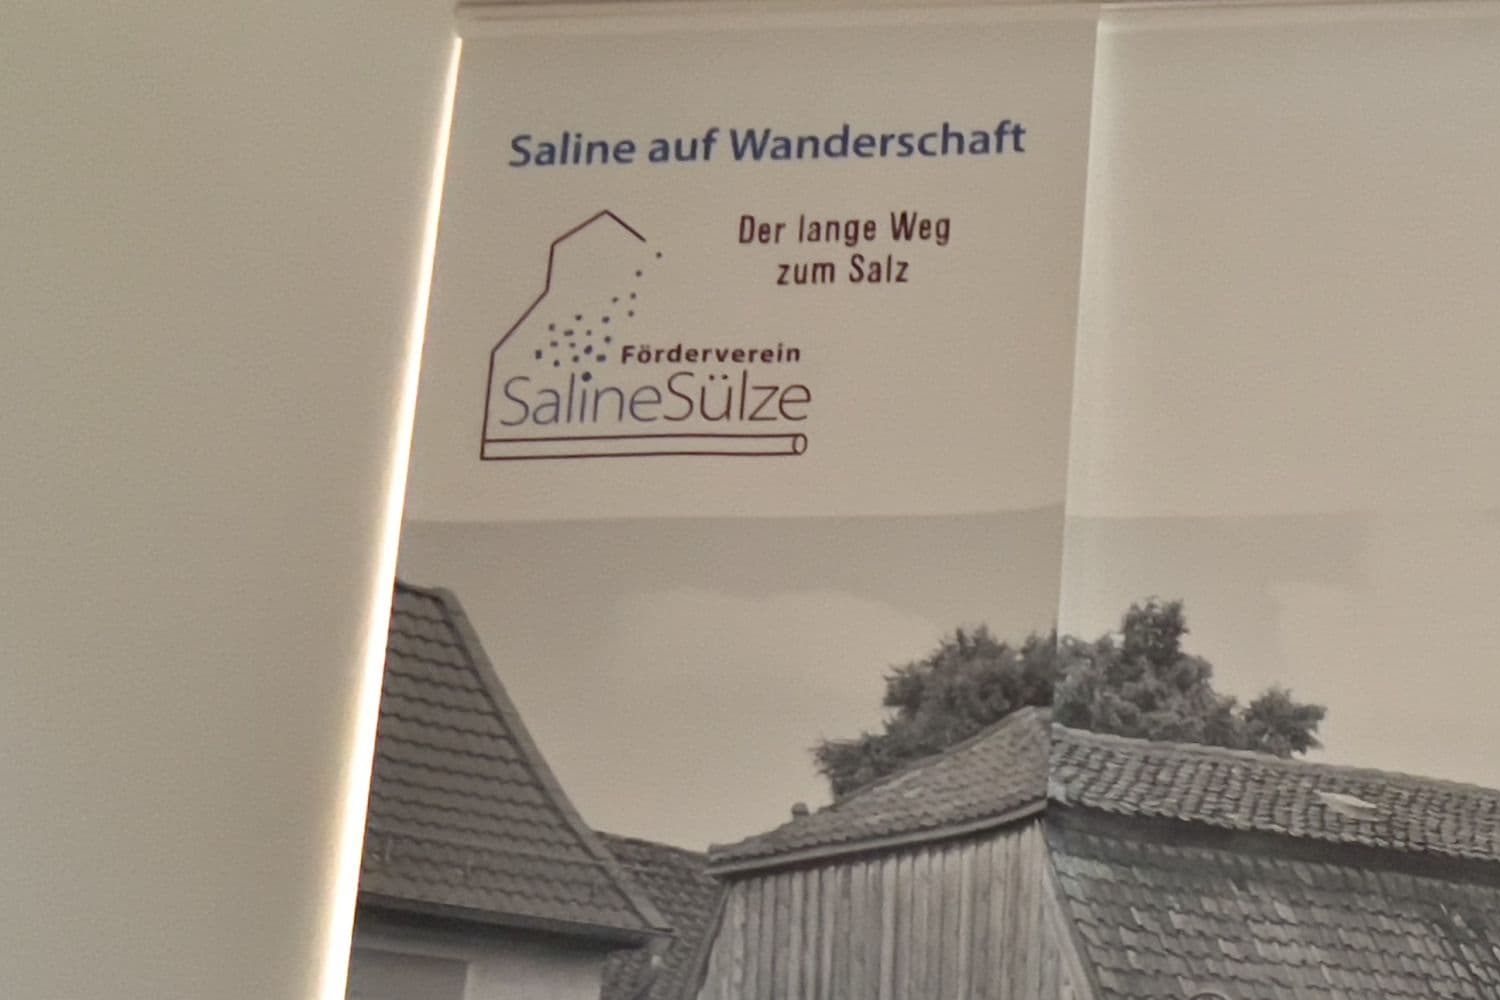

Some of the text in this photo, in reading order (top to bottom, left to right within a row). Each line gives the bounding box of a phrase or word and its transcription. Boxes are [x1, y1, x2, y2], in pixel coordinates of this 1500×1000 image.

[509, 120, 1026, 168] Saline auf Wanderschaft
[738, 211, 952, 249] Der lange Weg
[776, 255, 910, 286] zum Salz
[620, 343, 802, 366] Förderverein
[500, 370, 812, 426] SalineSülze
